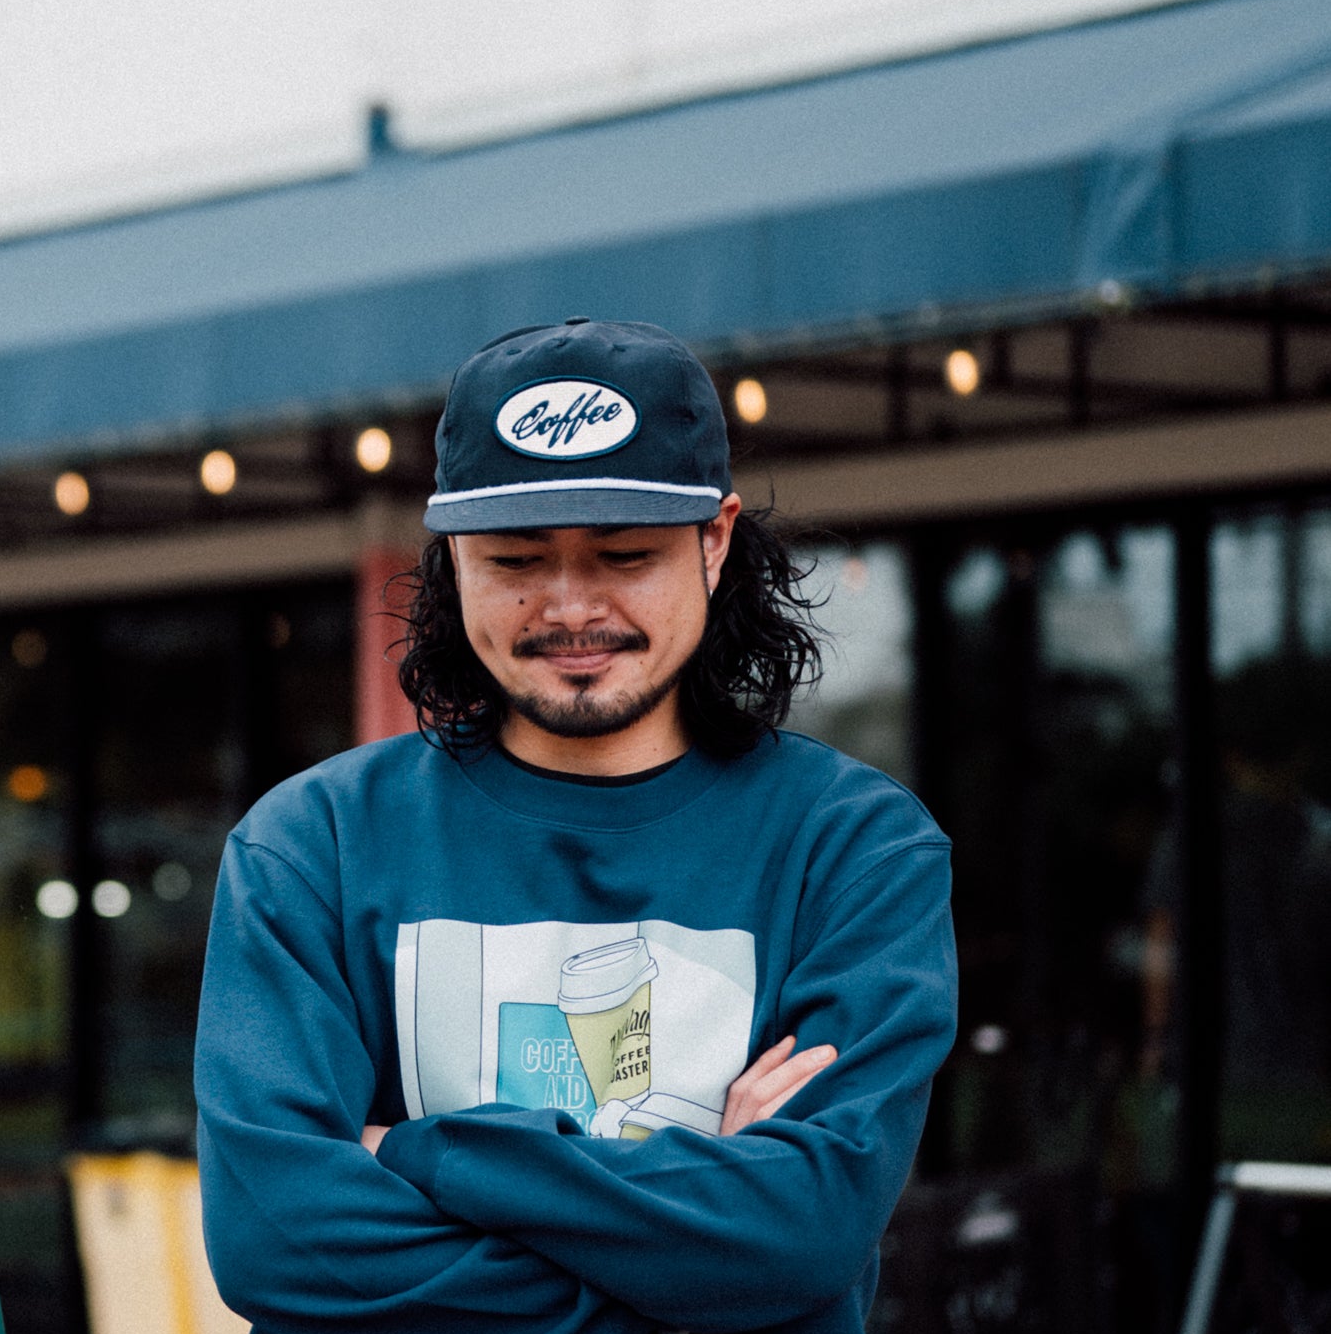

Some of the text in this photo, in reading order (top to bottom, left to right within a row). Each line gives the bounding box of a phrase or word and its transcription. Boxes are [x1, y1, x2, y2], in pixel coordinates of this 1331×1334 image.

[511, 389, 623, 449] Coffee
[610, 1060, 649, 1083] ASTER
[544, 1075, 588, 1109] AND
